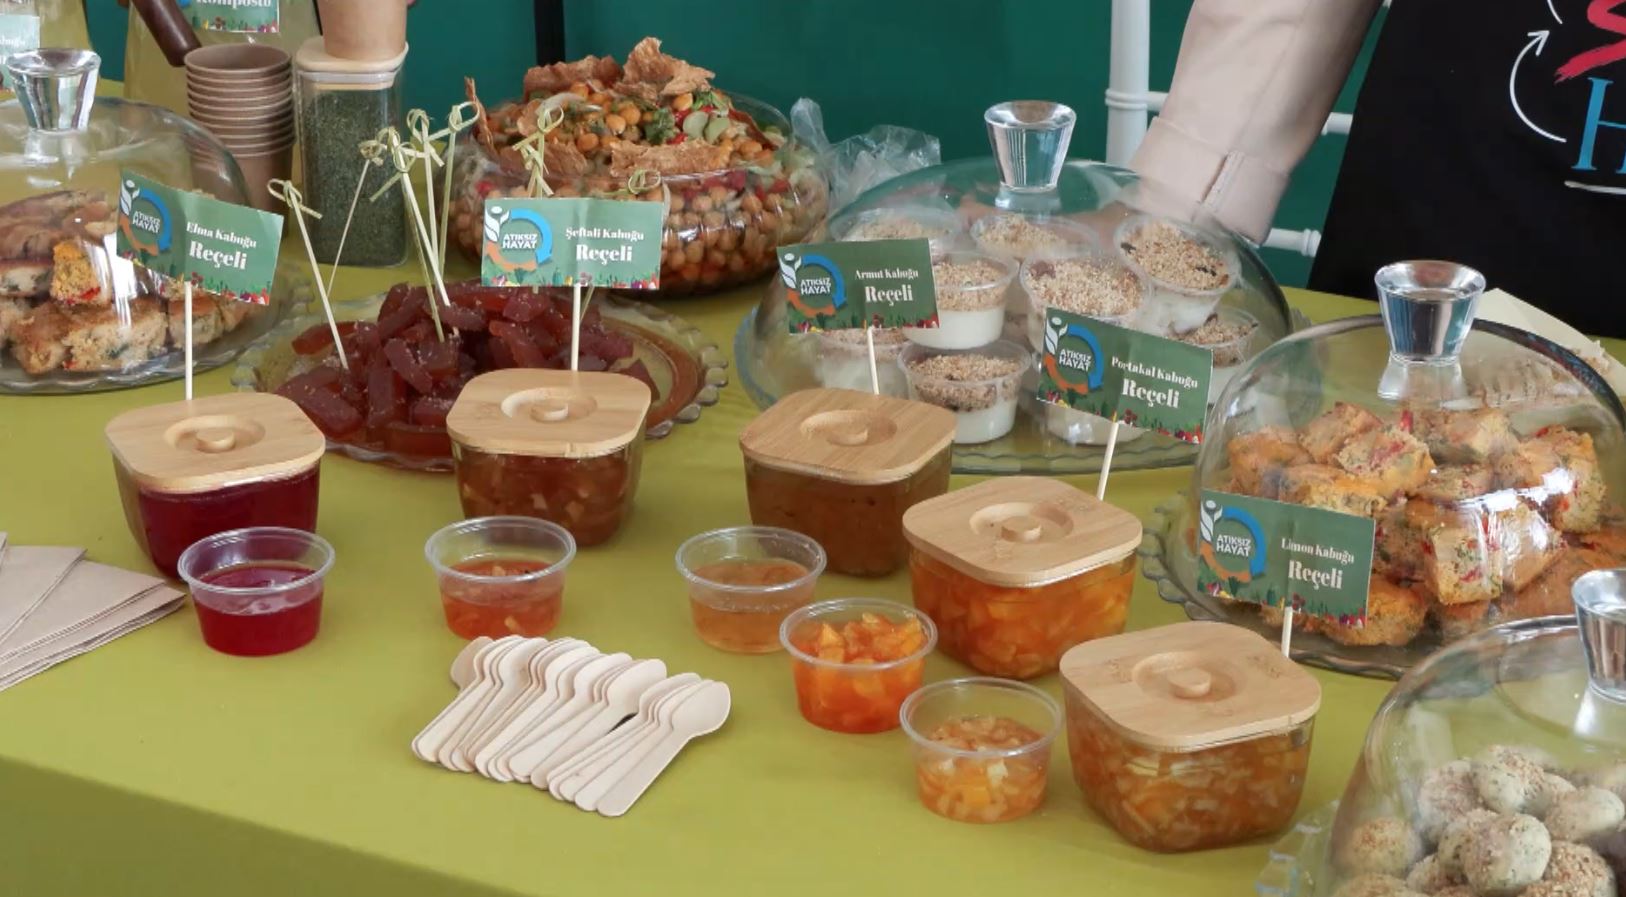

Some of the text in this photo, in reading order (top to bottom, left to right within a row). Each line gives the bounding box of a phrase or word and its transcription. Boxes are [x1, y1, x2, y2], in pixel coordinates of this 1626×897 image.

[132, 217, 160, 234] HAYAT
[186, 221, 257, 249] Elma Kabuğu
[503, 233, 538, 241] ATIKSIZ
[565, 227, 645, 242] Şeftali Kabuğu
[502, 240, 536, 249] HAYAT
[189, 240, 247, 270] Reçeli
[576, 244, 632, 265] Reçeli
[855, 267, 919, 280] Armut Kabuğu
[800, 277, 831, 287] ATIKSIZ
[800, 283, 831, 295] HAYAT
[865, 284, 913, 306] Reçeli
[1059, 356, 1090, 371] HAYAT
[1061, 349, 1092, 363] ATIKSIZ
[1111, 356, 1198, 389] Portakal Kabuğu
[1122, 378, 1180, 409] Reçeli
[1217, 534, 1251, 546] ATIKSIZ
[1216, 541, 1250, 557] HAYAT
[1281, 538, 1355, 565] Limon Kabuğu
[1288, 559, 1343, 590] Reçeli
